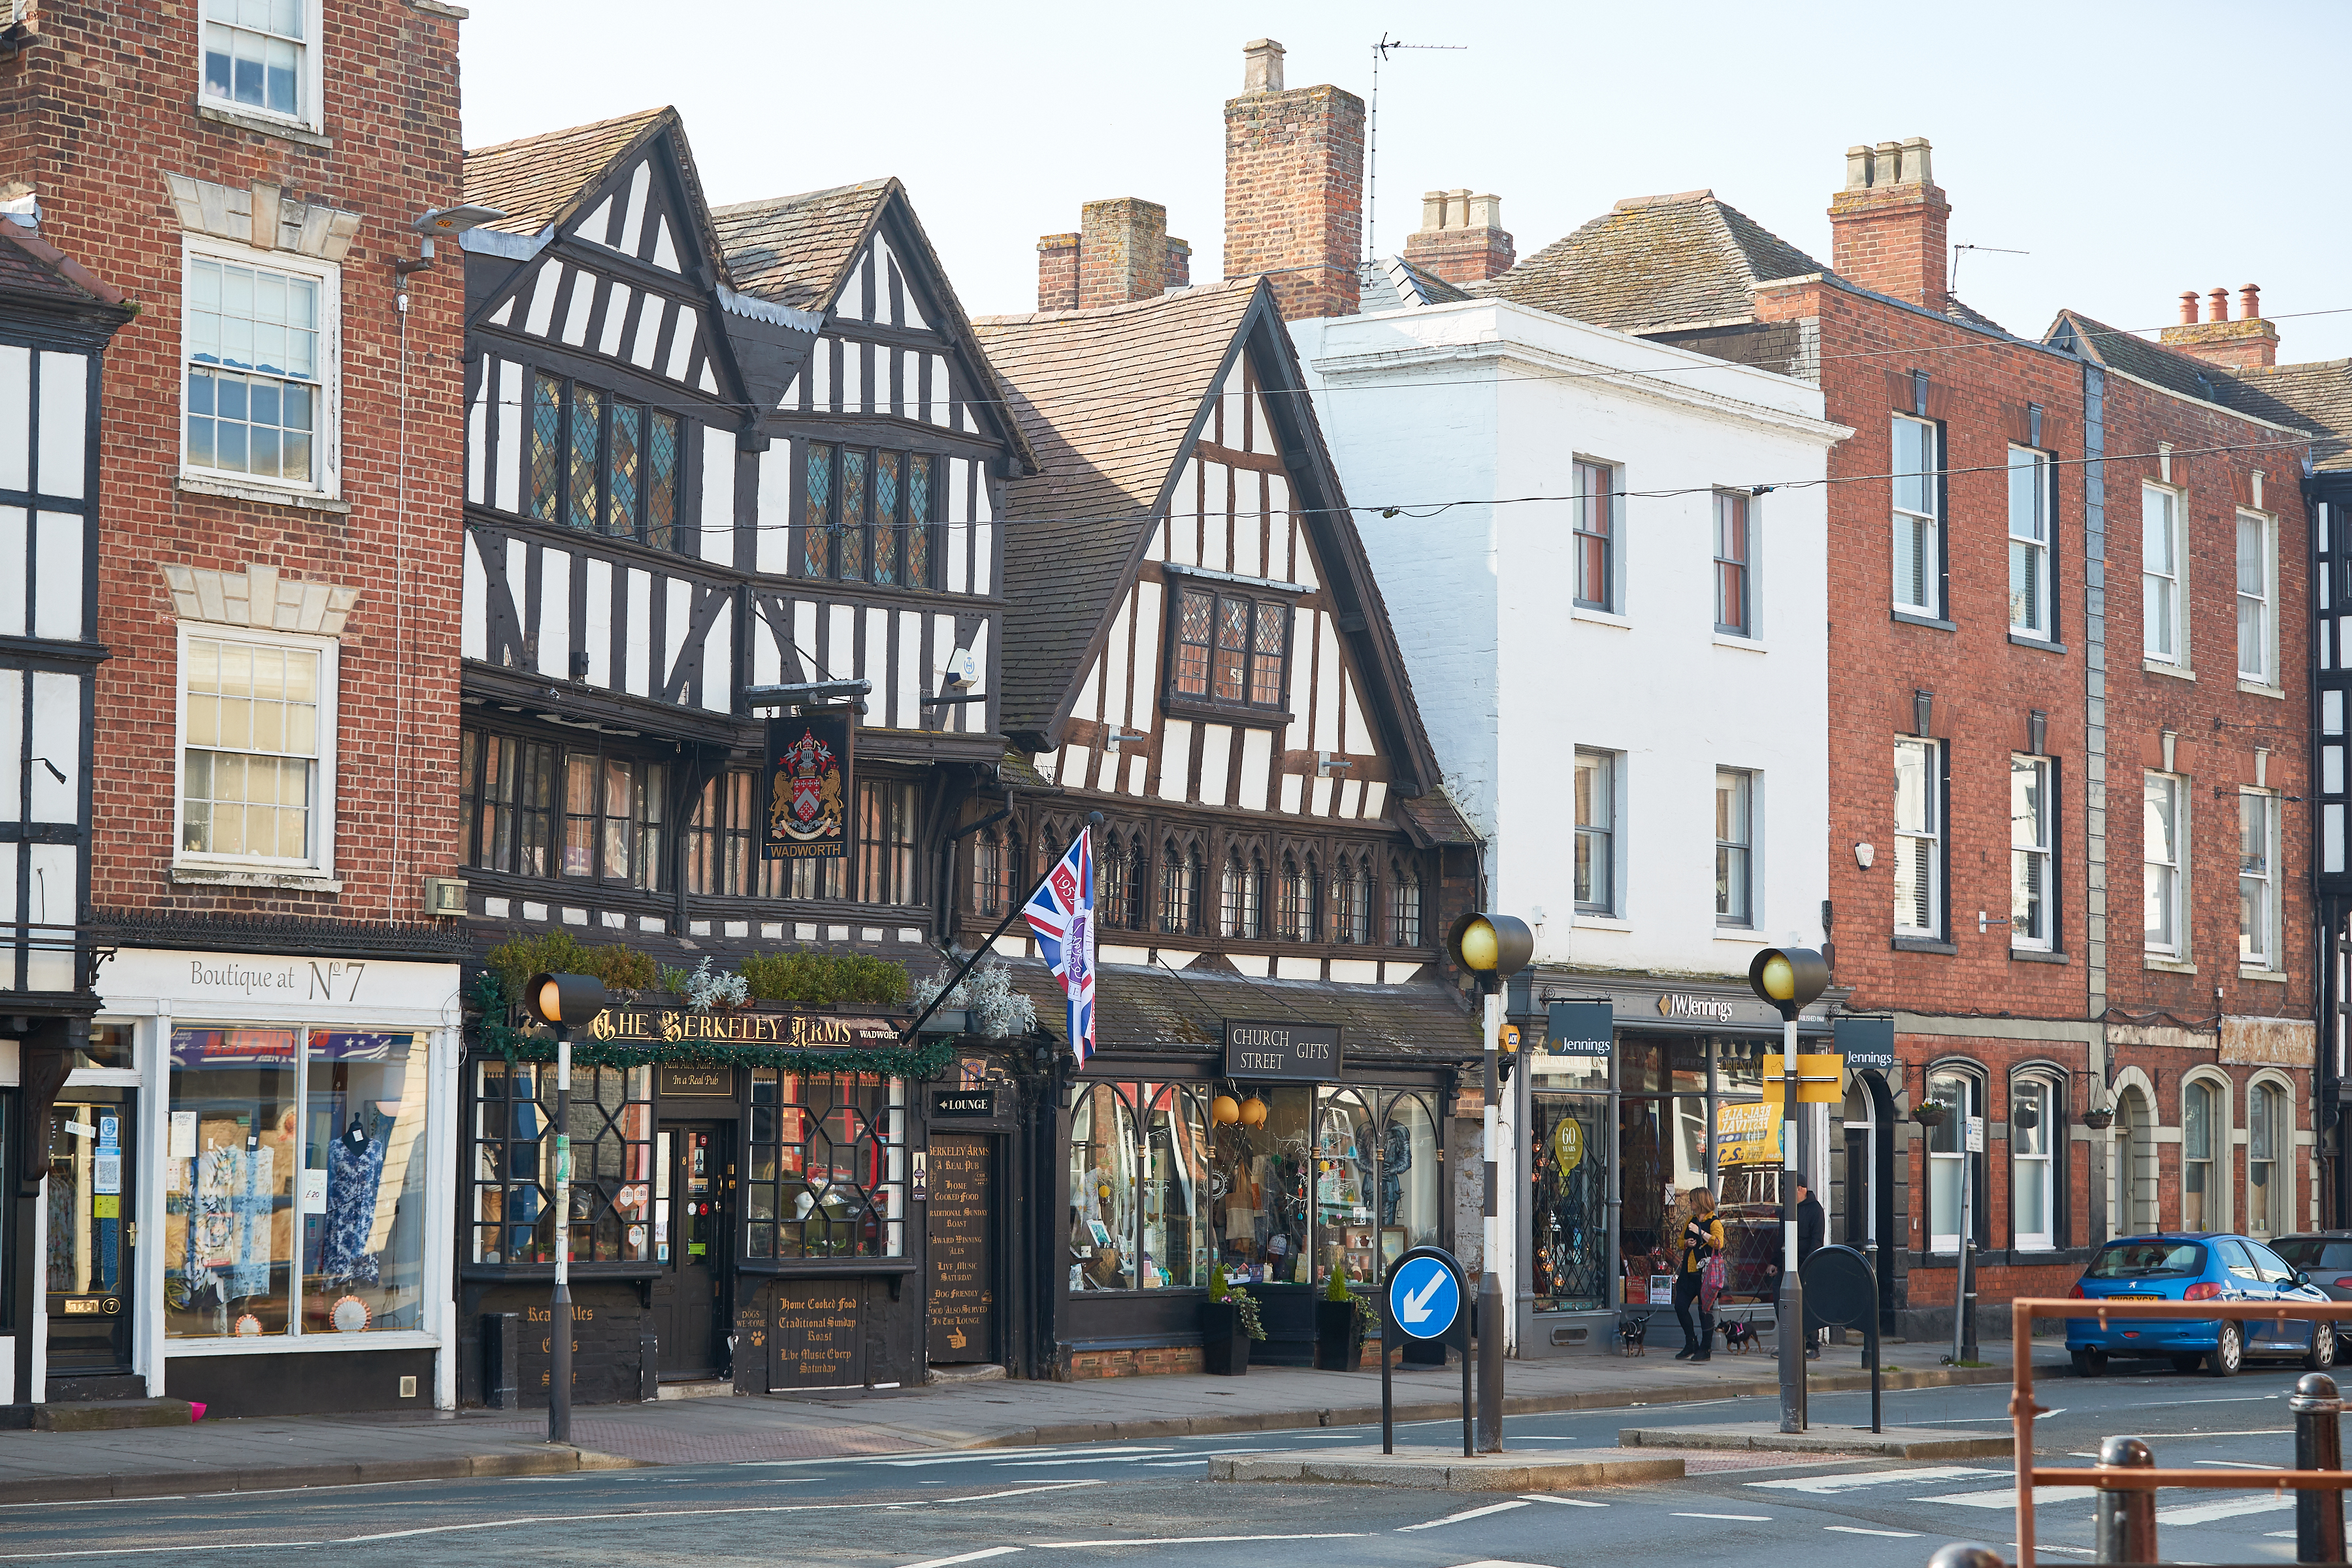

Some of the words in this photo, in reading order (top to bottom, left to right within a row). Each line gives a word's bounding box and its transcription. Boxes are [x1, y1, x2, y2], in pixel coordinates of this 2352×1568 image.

[787, 827, 797, 836] DIEU
[814, 825, 827, 836] NOUS
[771, 844, 841, 857] WADWORTH
[191, 960, 272, 995] Boutique
[277, 967, 295, 988] at
[1670, 994, 1733, 1022] JW.Jennings
[859, 1030, 899, 1039] WADWORT
[1233, 1029, 1290, 1047] CHURCH
[1509, 1036, 1517, 1044] ADT
[1296, 1043, 1329, 1059] GIFTS
[1563, 1037, 1610, 1054] Jennings
[1240, 1053, 1284, 1070] STREET
[1846, 1051, 1892, 1066] Jennings
[1721, 1059, 1761, 1073] ORIENTAL
[673, 1075, 681, 1085] In
[689, 1073, 704, 1085] Real
[704, 1073, 719, 1085] Pub
[949, 1099, 988, 1109] LOUNGE
[69, 1122, 93, 1134] CLOSED
[1563, 1128, 1576, 1145] 60
[682, 1156, 686, 1166] 8
[110, 1301, 114, 1311] 7
[779, 1298, 805, 1313] Home
[808, 1298, 835, 1309] Cooked
[837, 1298, 857, 1311] Food
[527, 1307, 550, 1321] Rea
[779, 1316, 826, 1328] Traditional
[827, 1316, 856, 1331] Sunday
[808, 1330, 832, 1341] Roast
[781, 1348, 798, 1360] Live
[800, 1348, 826, 1362] Music
[827, 1348, 851, 1362] Every
[800, 1363, 836, 1377] Saturday
